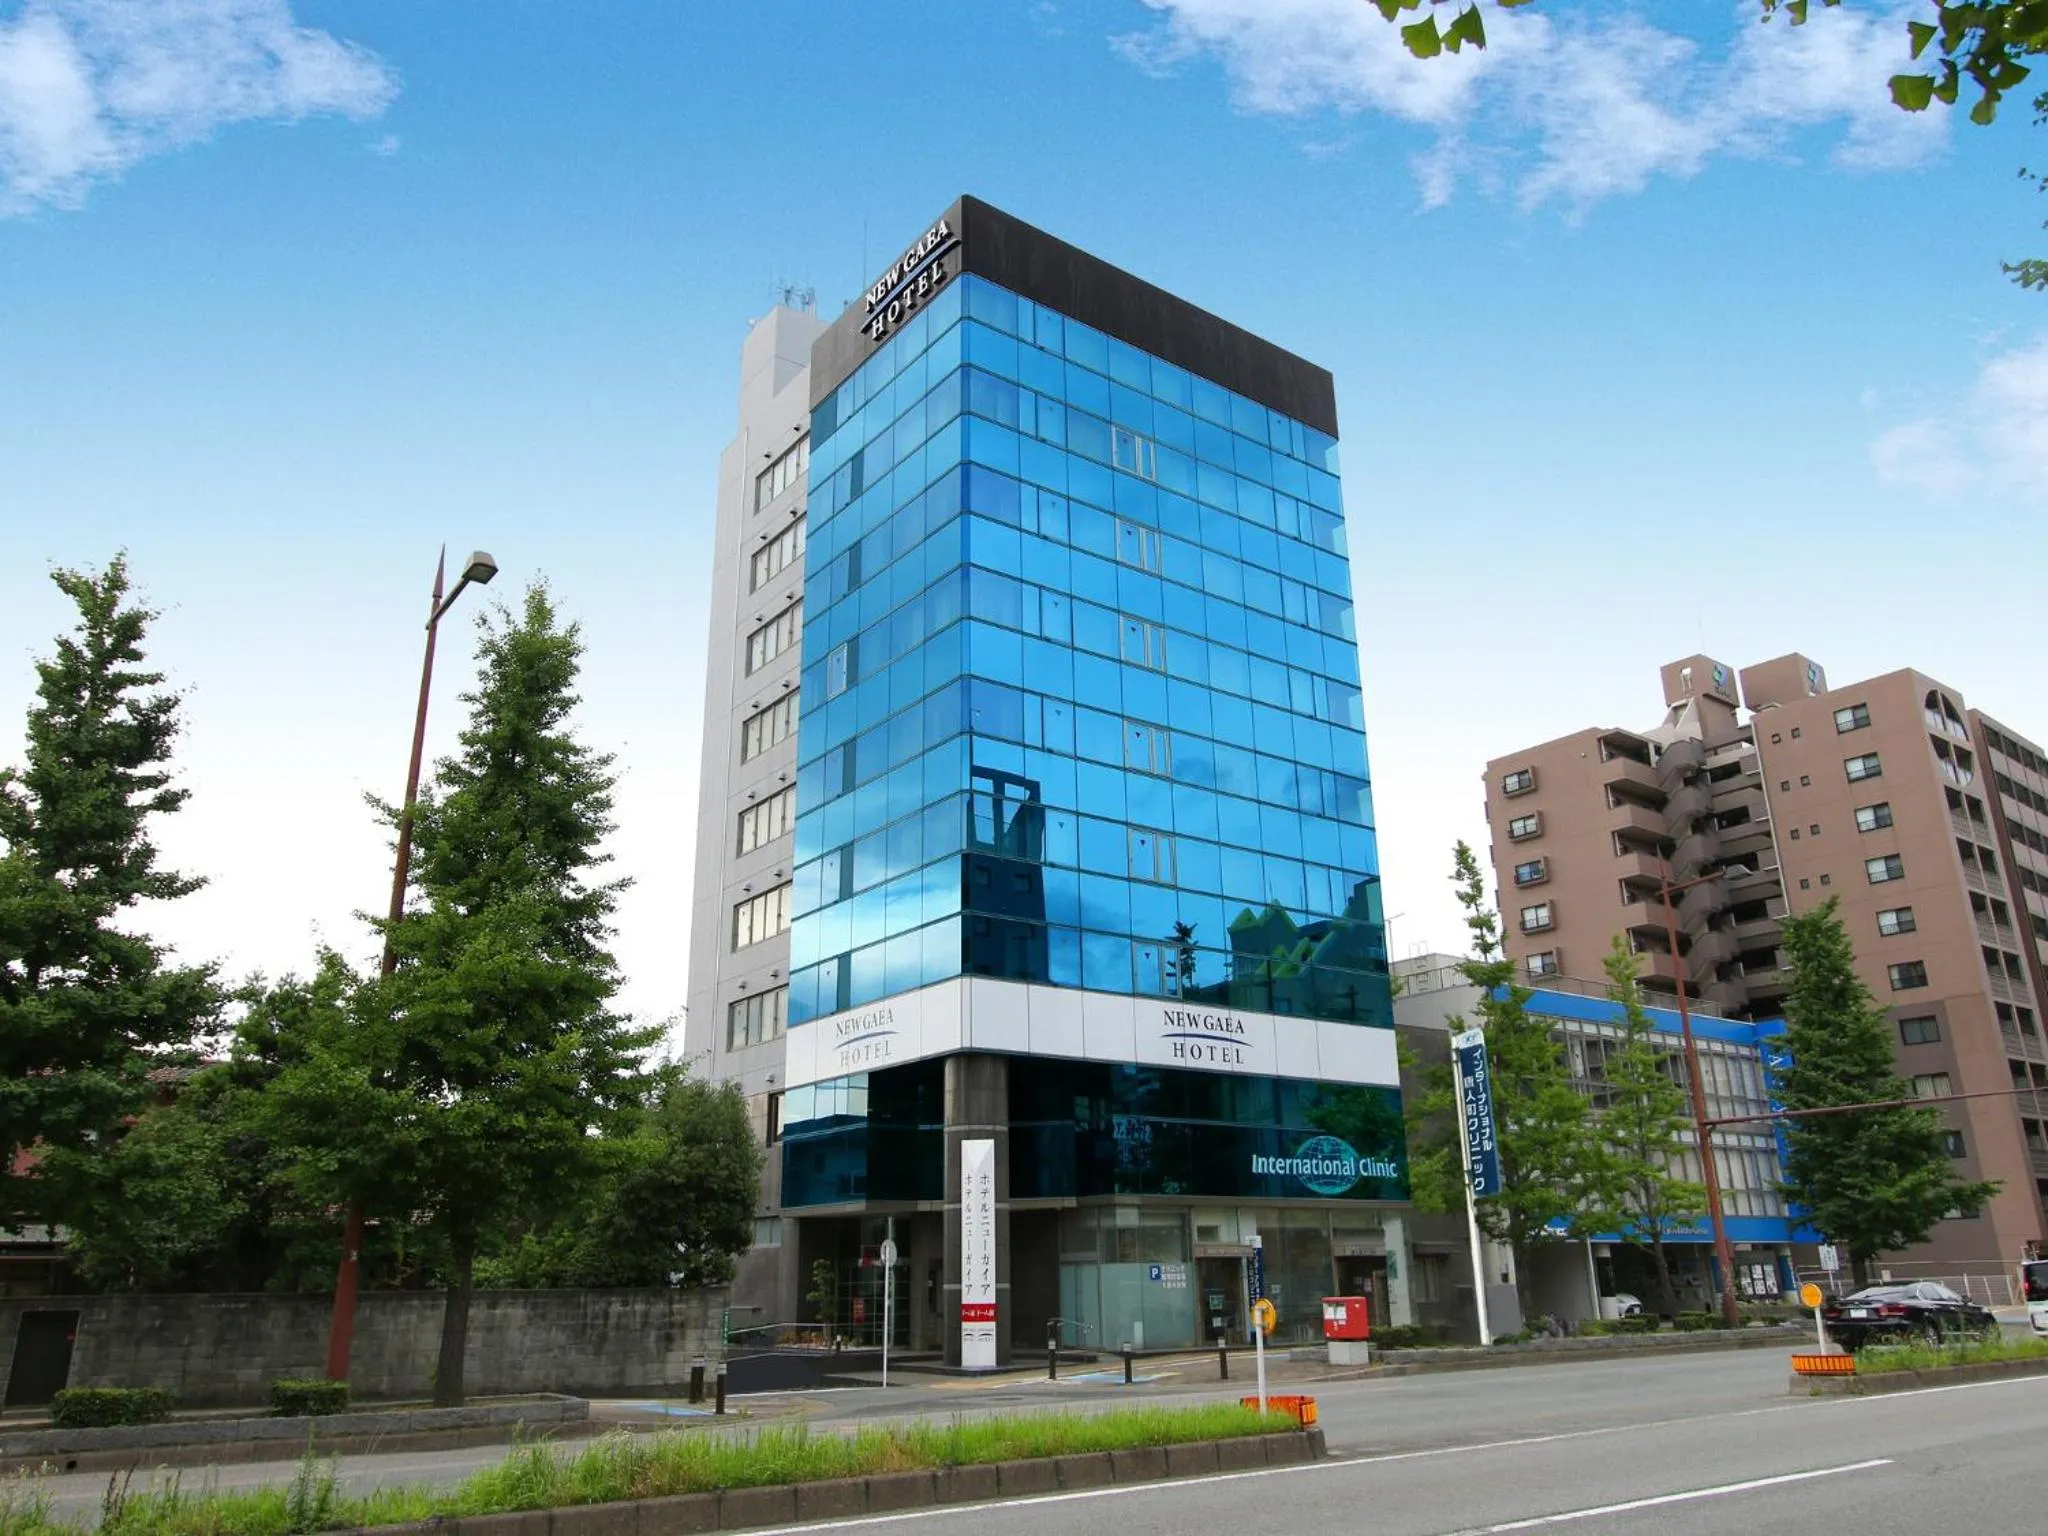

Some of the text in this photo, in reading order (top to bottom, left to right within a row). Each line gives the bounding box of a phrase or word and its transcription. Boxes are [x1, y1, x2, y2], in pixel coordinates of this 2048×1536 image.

[865, 219, 949, 312] NEW GAEA
[872, 259, 943, 340] HOTEL
[836, 1007, 894, 1037] NEW GAEA
[1163, 1010, 1245, 1034] NEW GAEA
[840, 1039, 892, 1067] HOTEL
[1173, 1042, 1245, 1065] HOTEL
[1472, 1048, 1493, 1151] インターナショナル
[1251, 1153, 1399, 1178] International Clinic
[979, 1172, 991, 1296] ホテルニューガイア
